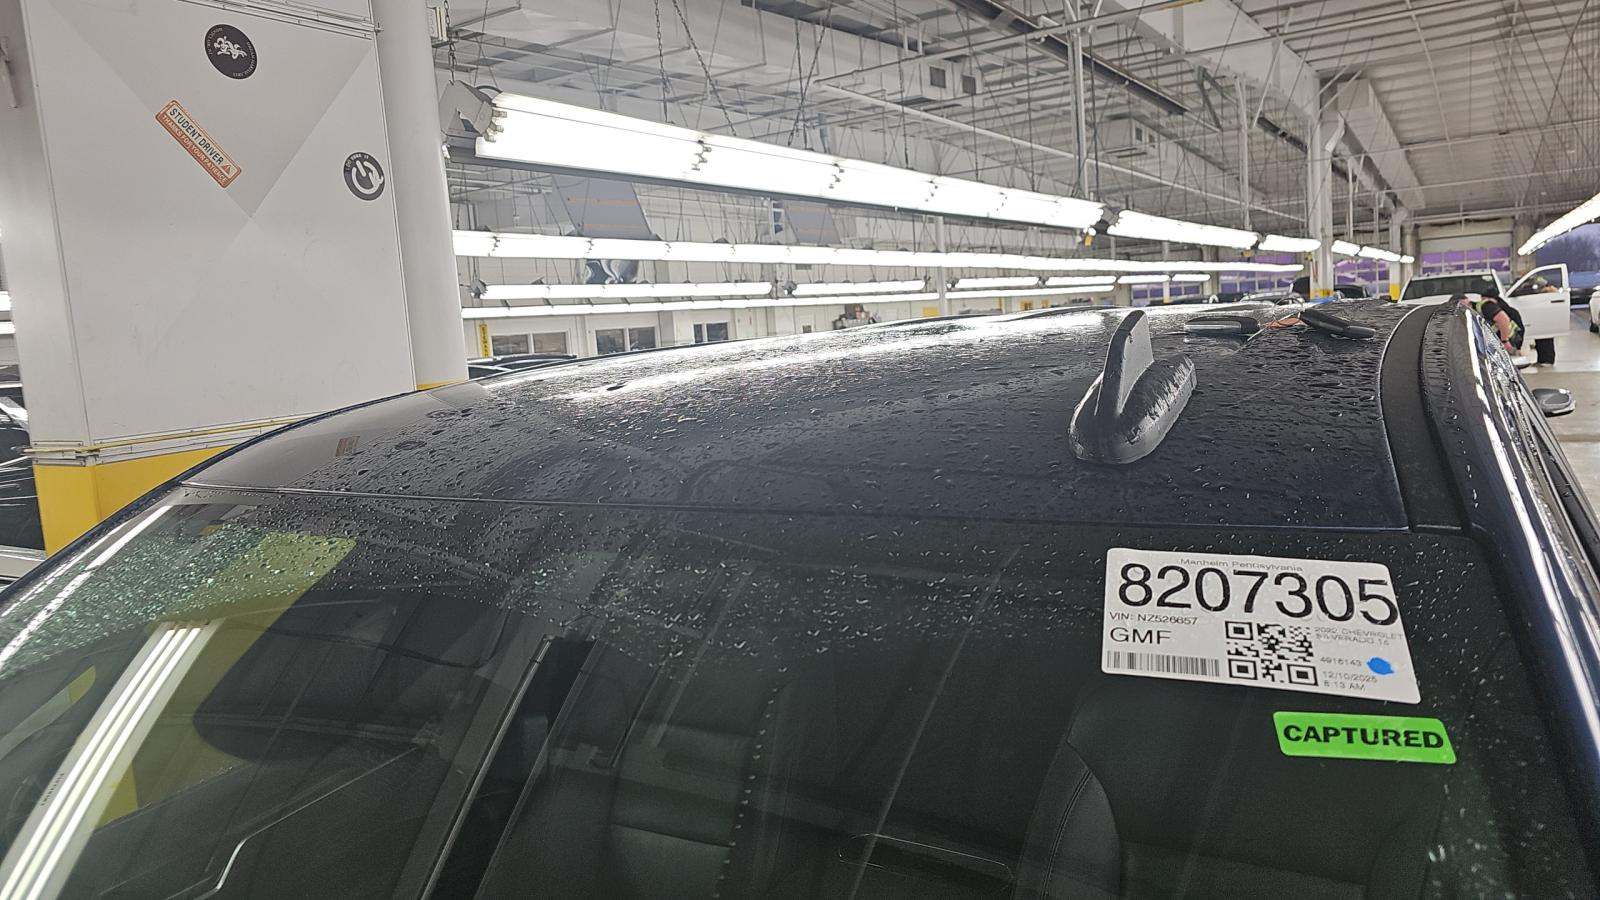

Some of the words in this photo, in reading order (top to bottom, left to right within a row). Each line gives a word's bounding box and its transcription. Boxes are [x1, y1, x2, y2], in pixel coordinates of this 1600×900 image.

[169, 108, 202, 142] STUDENT
[198, 138, 224, 165] DRIVER
[1180, 558, 1228, 567] Manheim
[1118, 563, 1399, 626] 8207305
[1110, 612, 1134, 621] VIN:
[1110, 627, 1172, 644] GMF
[1283, 725, 1444, 749] CAPTURED
